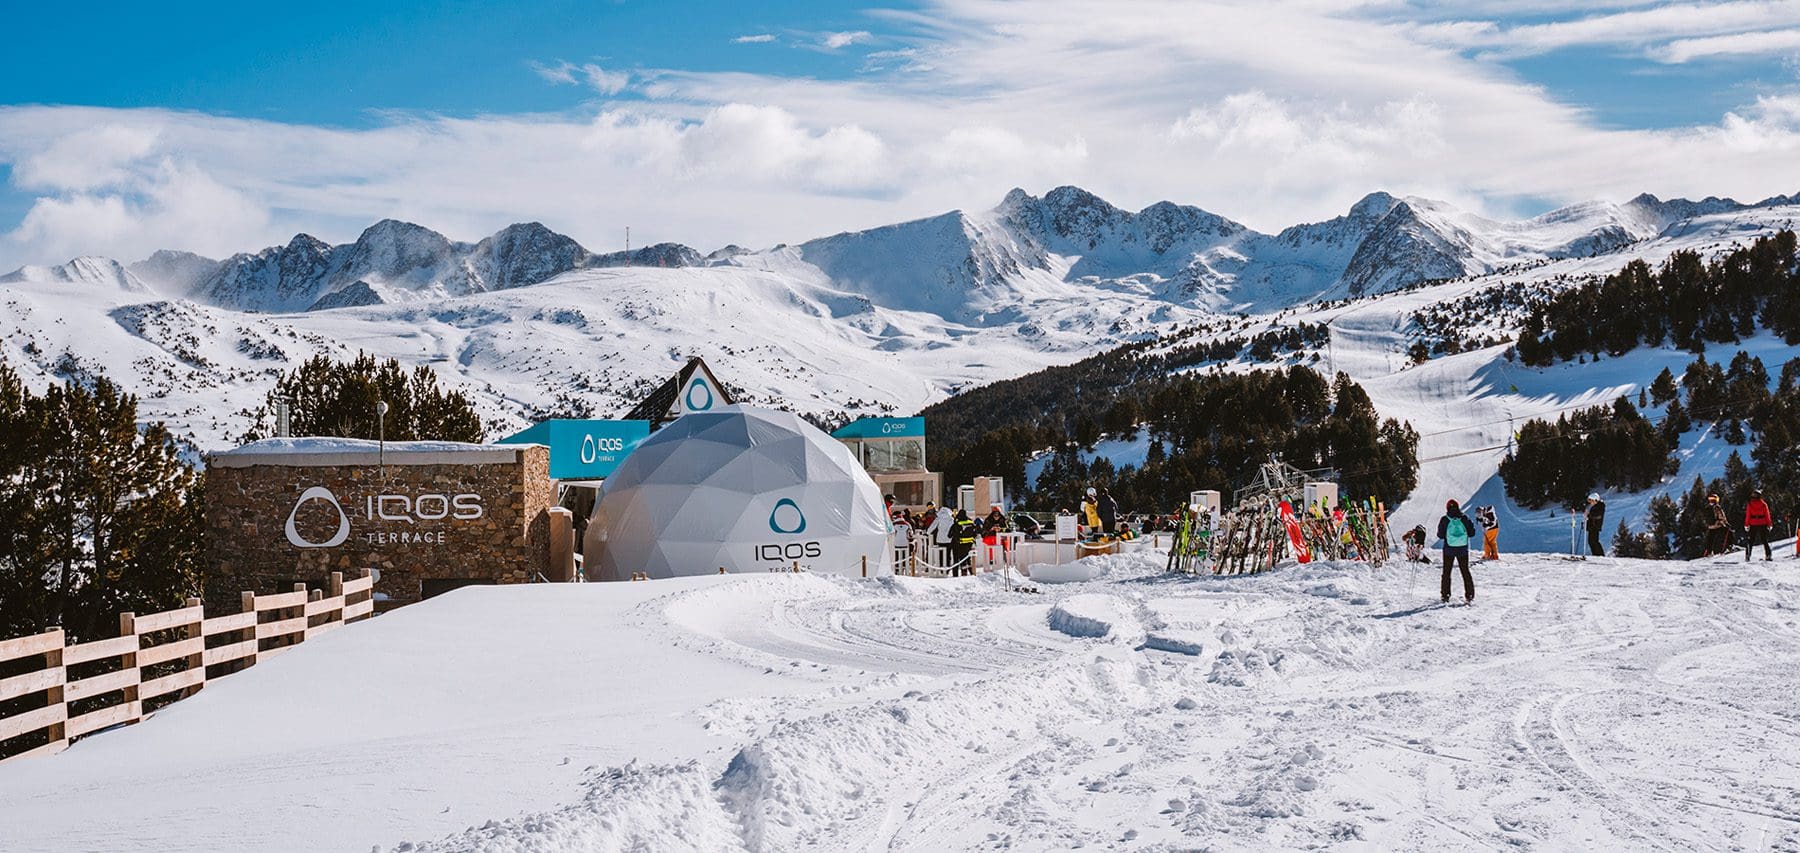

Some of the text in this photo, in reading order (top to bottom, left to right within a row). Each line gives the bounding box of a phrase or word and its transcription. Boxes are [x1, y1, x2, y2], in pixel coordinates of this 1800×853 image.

[598, 438, 622, 452] IQOS
[367, 494, 482, 524] IQOS
[367, 532, 445, 543] TERRACE
[755, 542, 821, 562] IQOS
[769, 565, 812, 573] TERRCE
